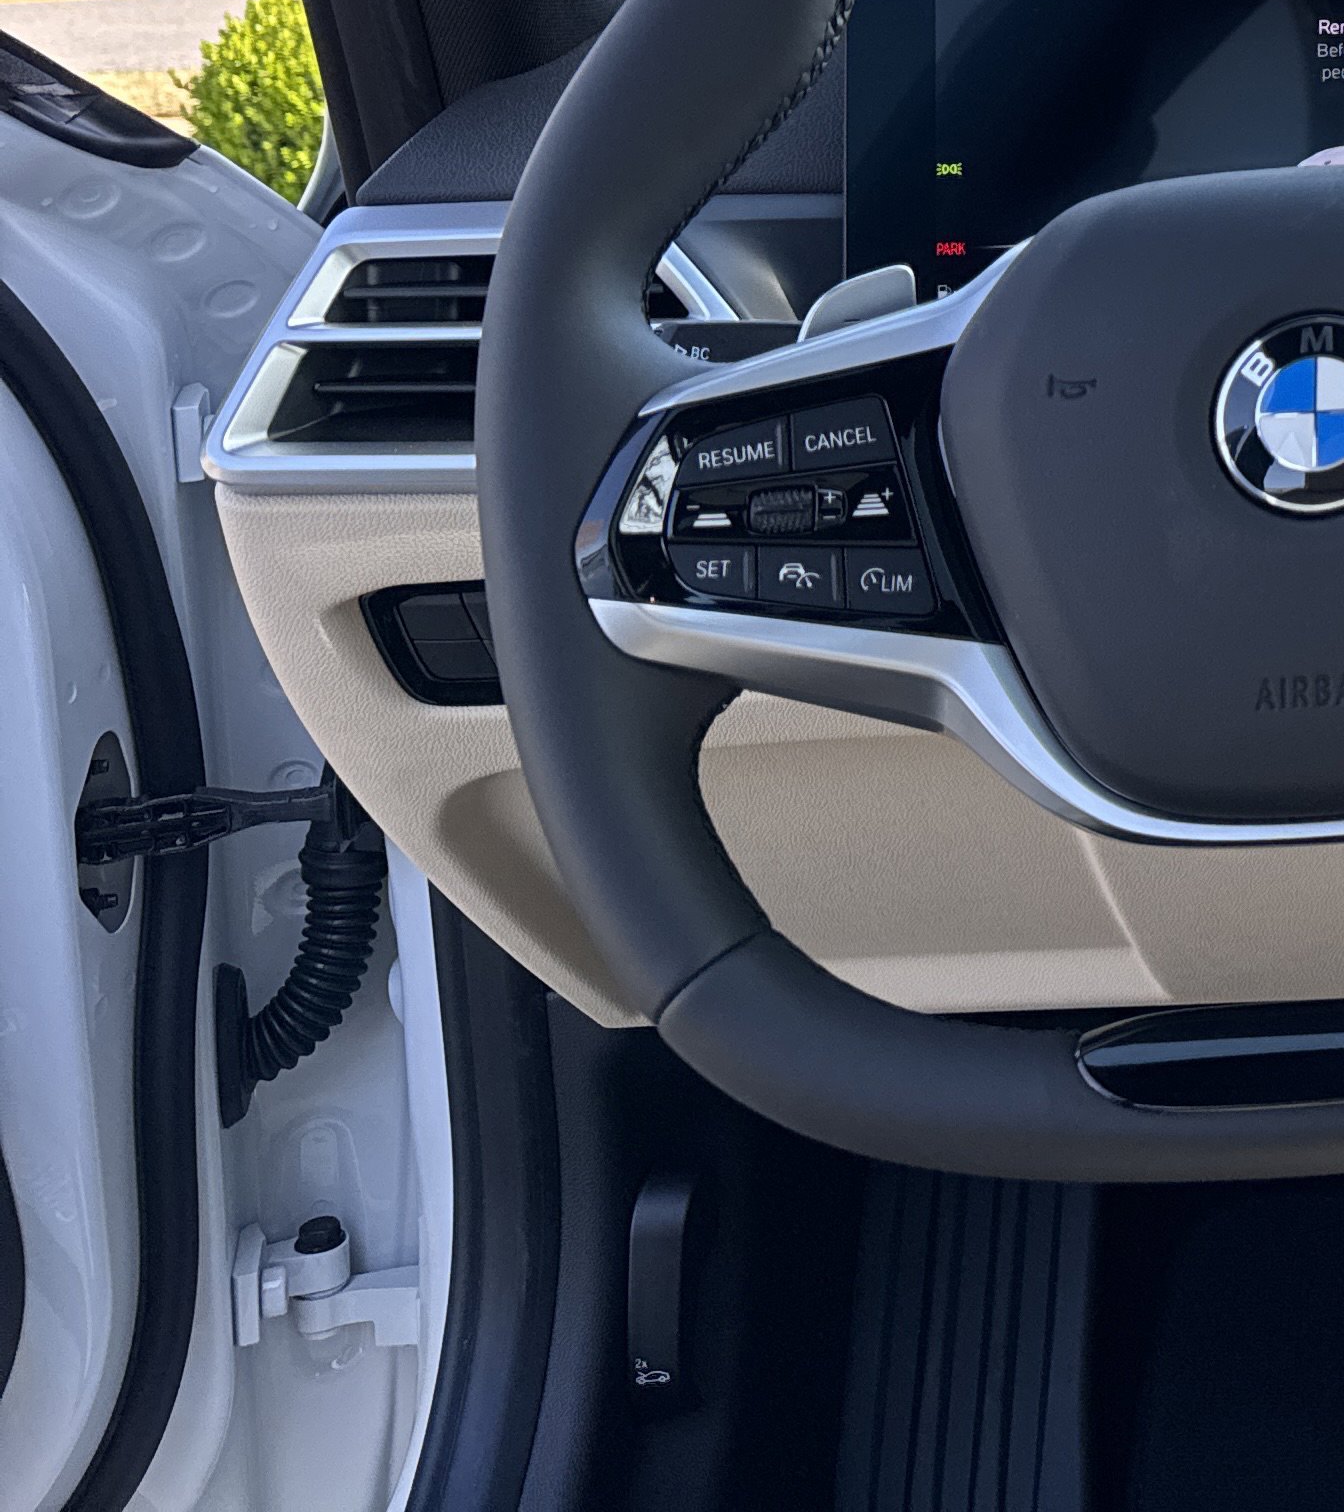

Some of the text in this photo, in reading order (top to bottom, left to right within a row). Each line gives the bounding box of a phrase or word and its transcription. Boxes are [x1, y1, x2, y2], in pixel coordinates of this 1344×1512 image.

[936, 242, 967, 257] PARK
[690, 346, 711, 361] BC
[804, 426, 878, 452] CANCEL
[698, 441, 776, 469] RESUME
[695, 559, 731, 579] SET
[881, 574, 913, 592] LIM
